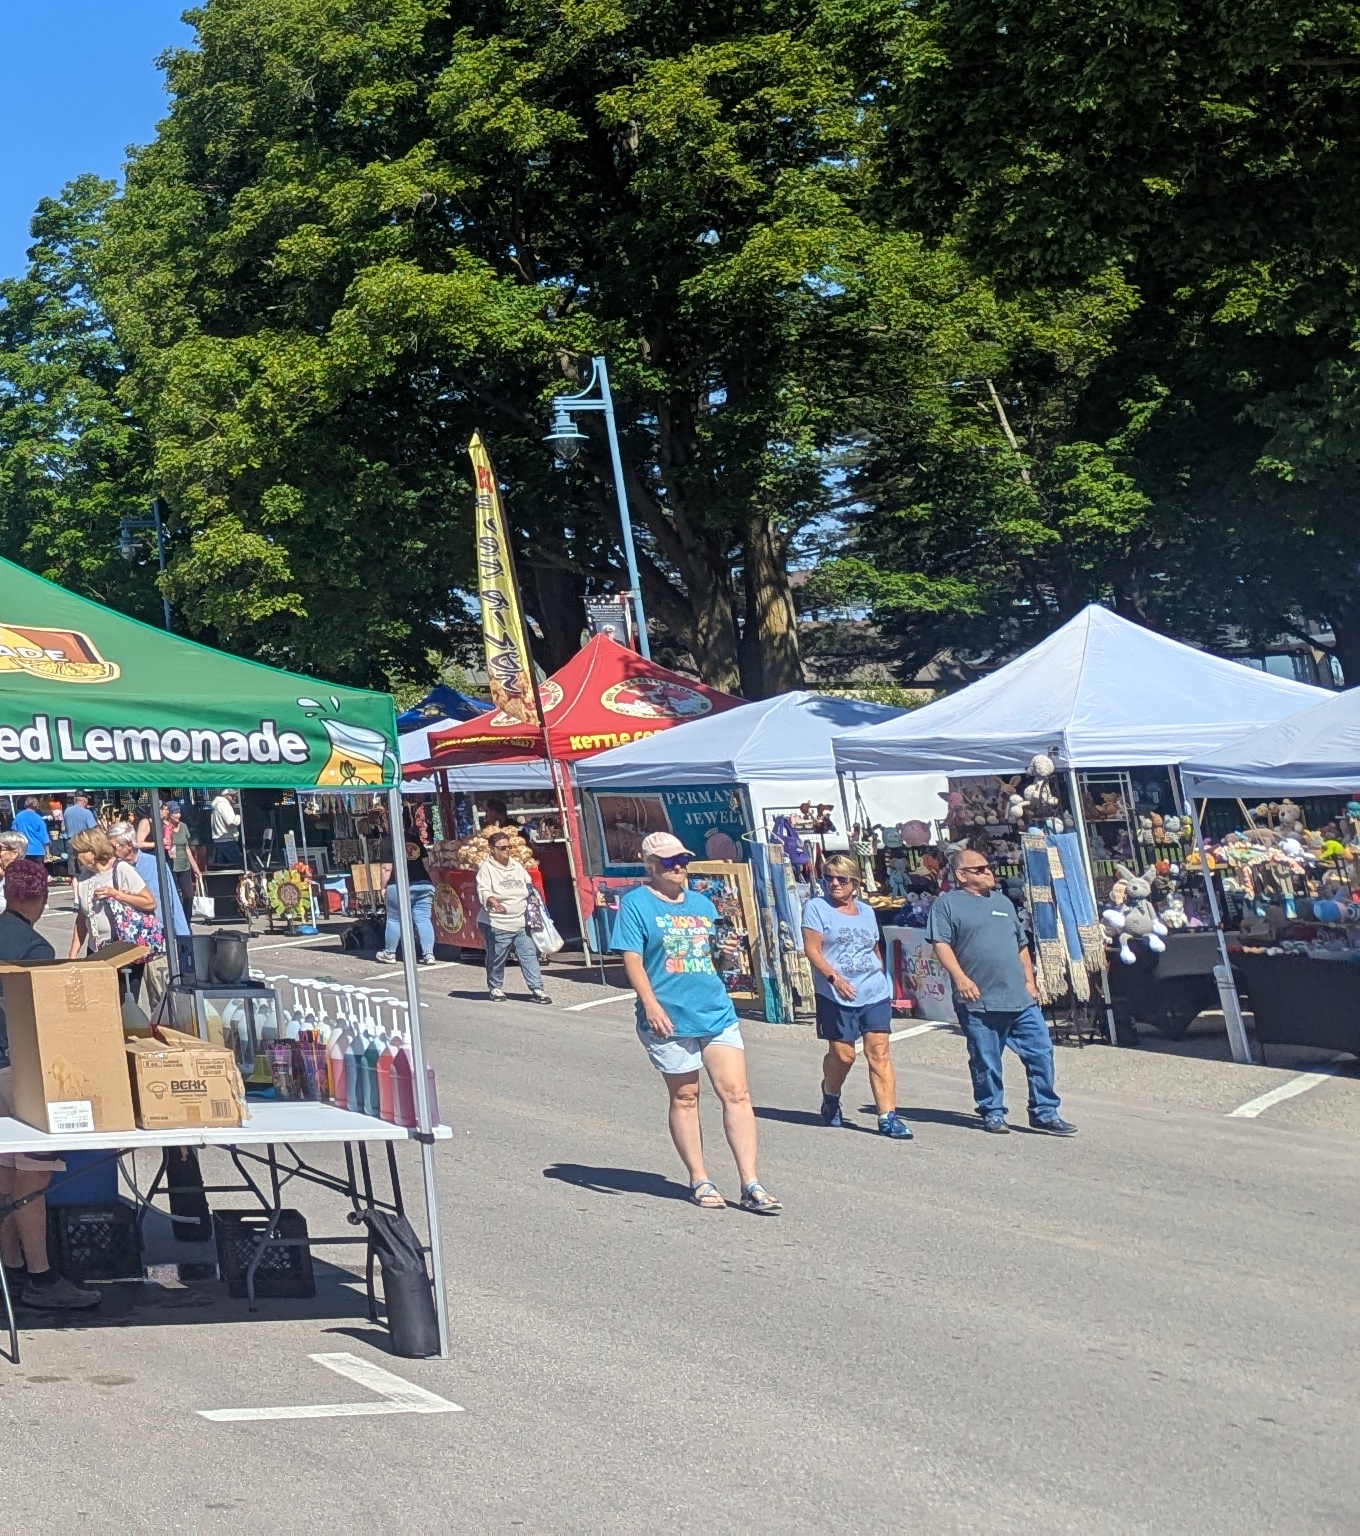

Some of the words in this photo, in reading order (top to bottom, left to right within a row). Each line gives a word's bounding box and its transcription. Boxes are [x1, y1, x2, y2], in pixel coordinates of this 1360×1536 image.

[58, 719, 309, 766] Lemonade
[665, 789, 733, 806] PERMAN
[685, 810, 745, 826] JEWEL
